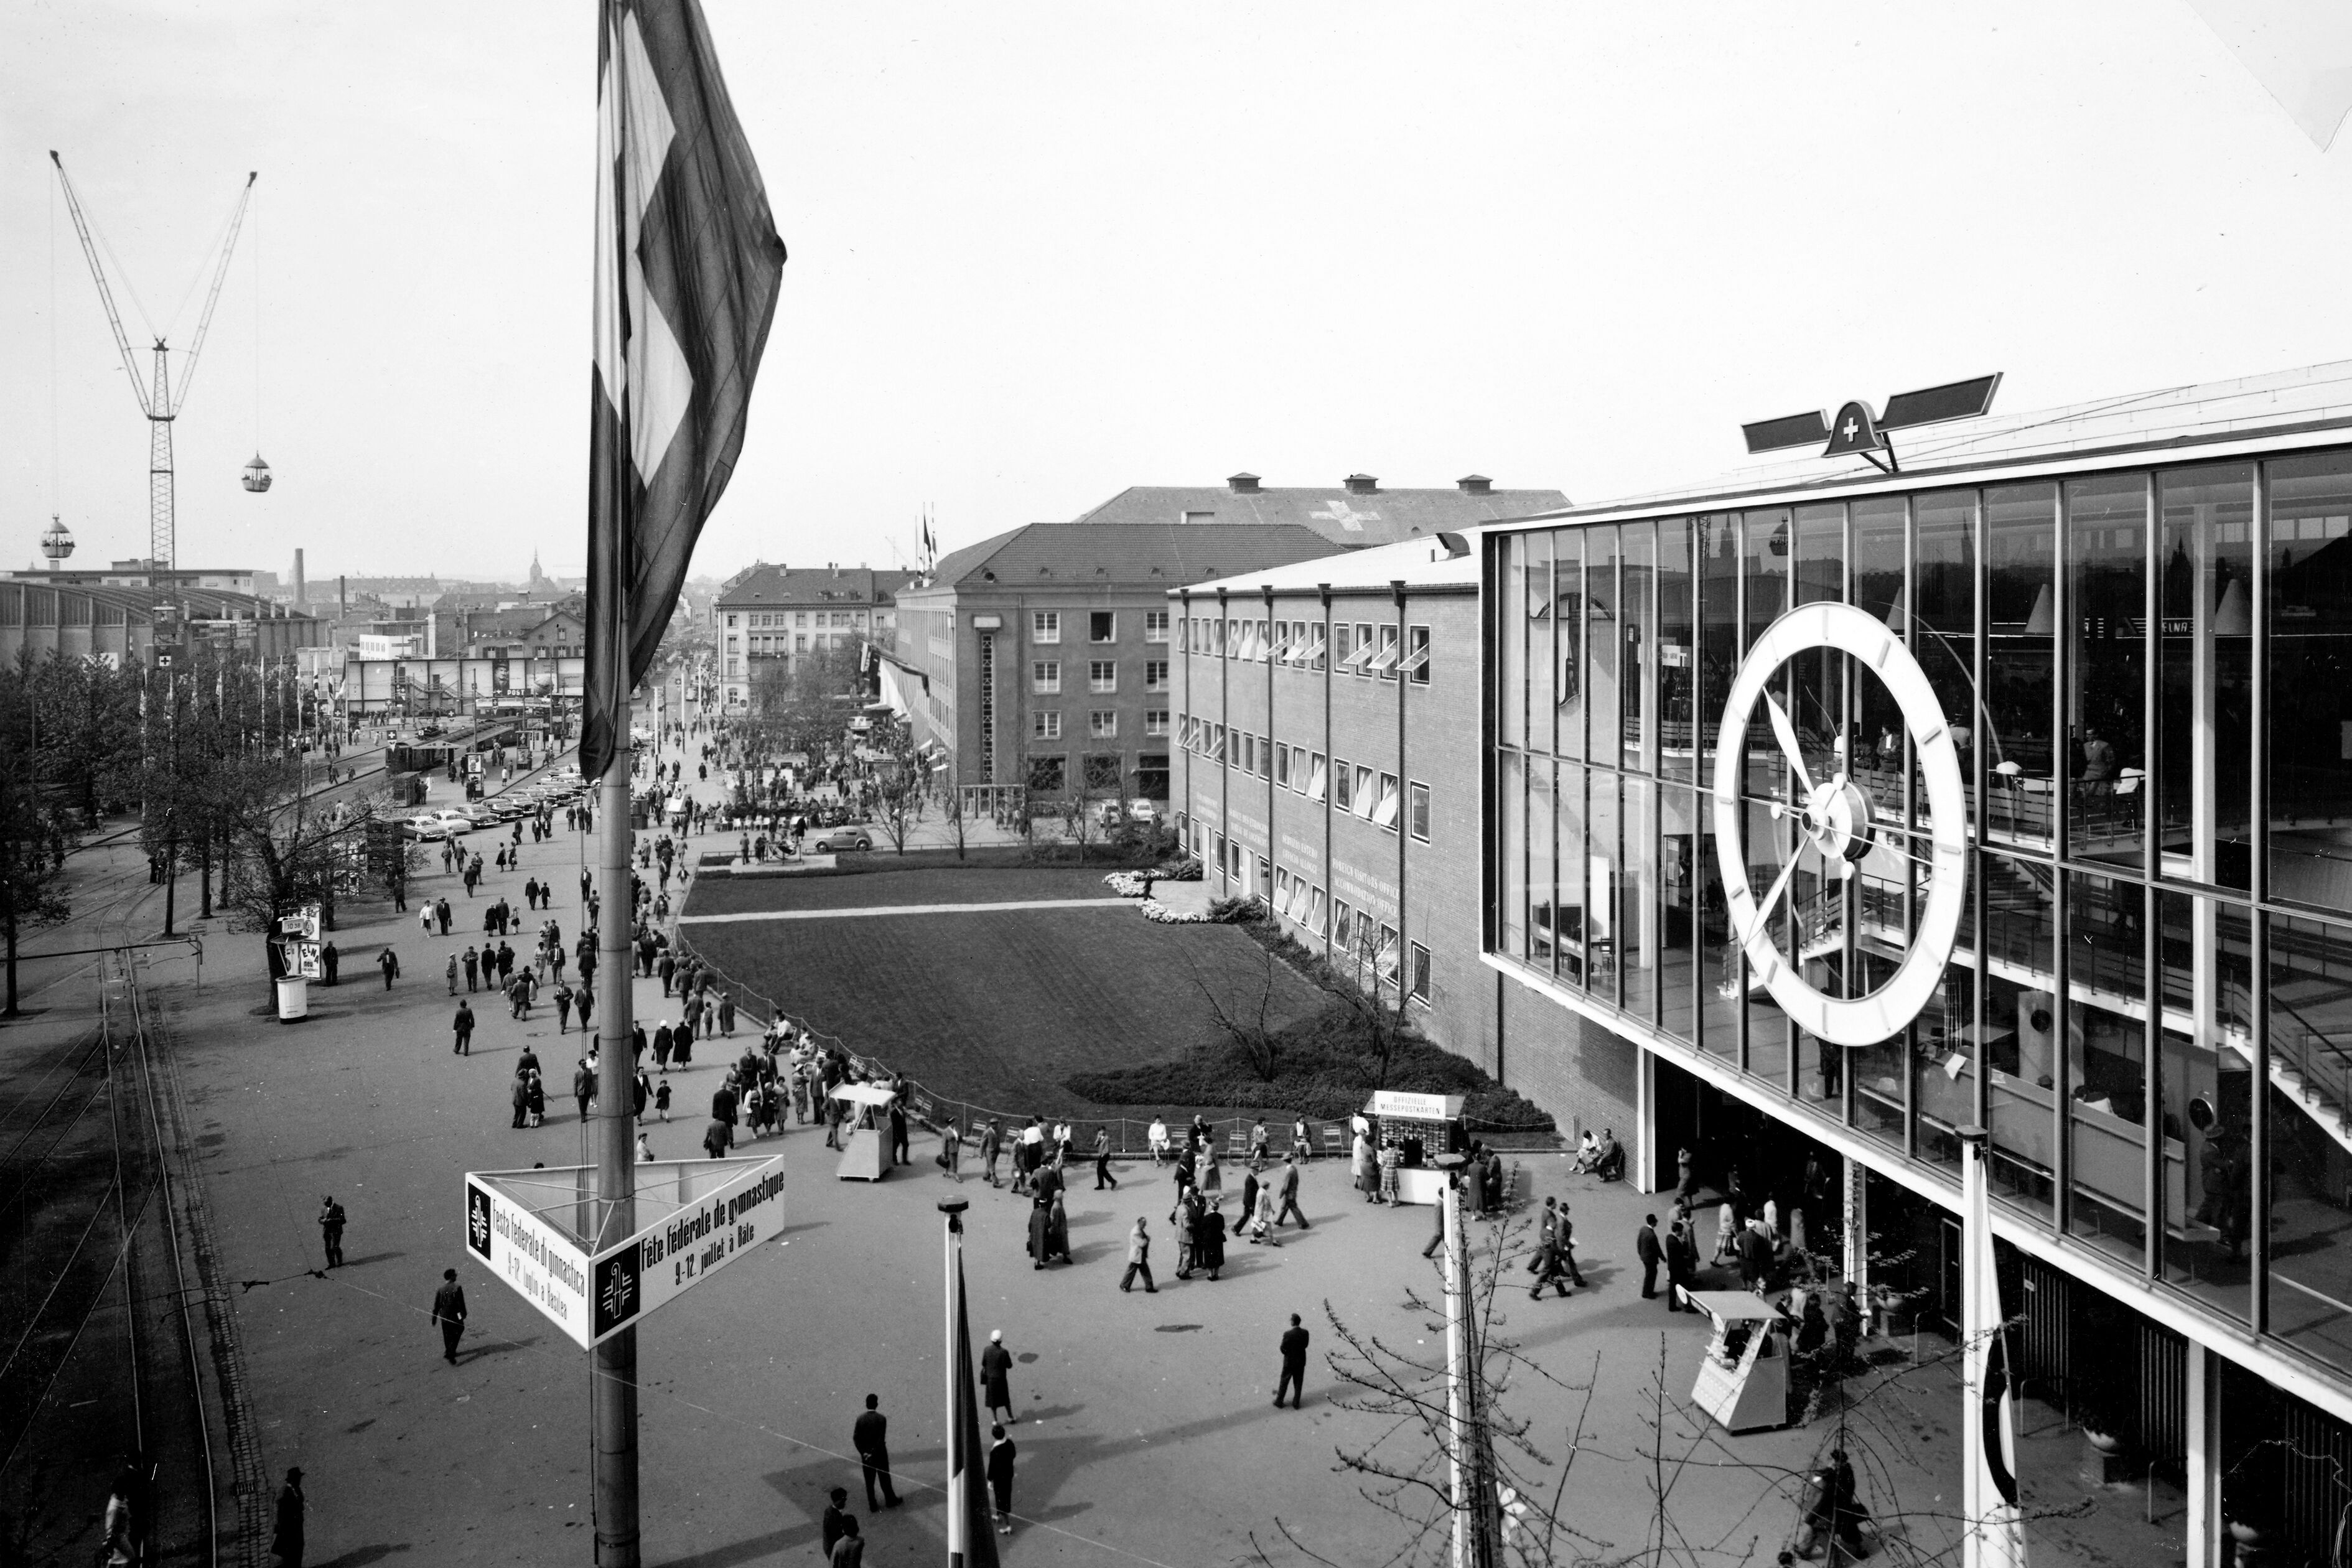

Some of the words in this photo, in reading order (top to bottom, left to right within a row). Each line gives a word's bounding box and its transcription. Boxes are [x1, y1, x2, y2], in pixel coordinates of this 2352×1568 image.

[1282, 834, 1300, 851] SERVIZIO
[1301, 842, 1318, 859] ESTERO
[1332, 858, 1353, 877] FOREIGN
[1354, 868, 1378, 889] VISITORS
[1379, 880, 1399, 900] OFFICE
[1335, 876, 1376, 905] ACCOMMODATION
[1377, 898, 1398, 918] OFFICE
[302, 945, 319, 964] ELNA
[1381, 1104, 1440, 1114] MESSEPOSTKARTEN
[1394, 1096, 1426, 1105] OFFIZIELLE
[642, 1235, 663, 1272] Fête
[667, 1207, 711, 1256] fédérale
[714, 1198, 725, 1229] de
[729, 1171, 783, 1226] gymnastique
[493, 1199, 509, 1238] Festa
[511, 1213, 539, 1262] federale
[541, 1236, 547, 1268] di
[549, 1249, 584, 1297] ginnastica
[700, 1238, 724, 1276] juillet
[729, 1233, 734, 1253] à
[738, 1222, 754, 1248] Bâle
[541, 1285, 544, 1301] a
[548, 1282, 567, 1320] Basilea
